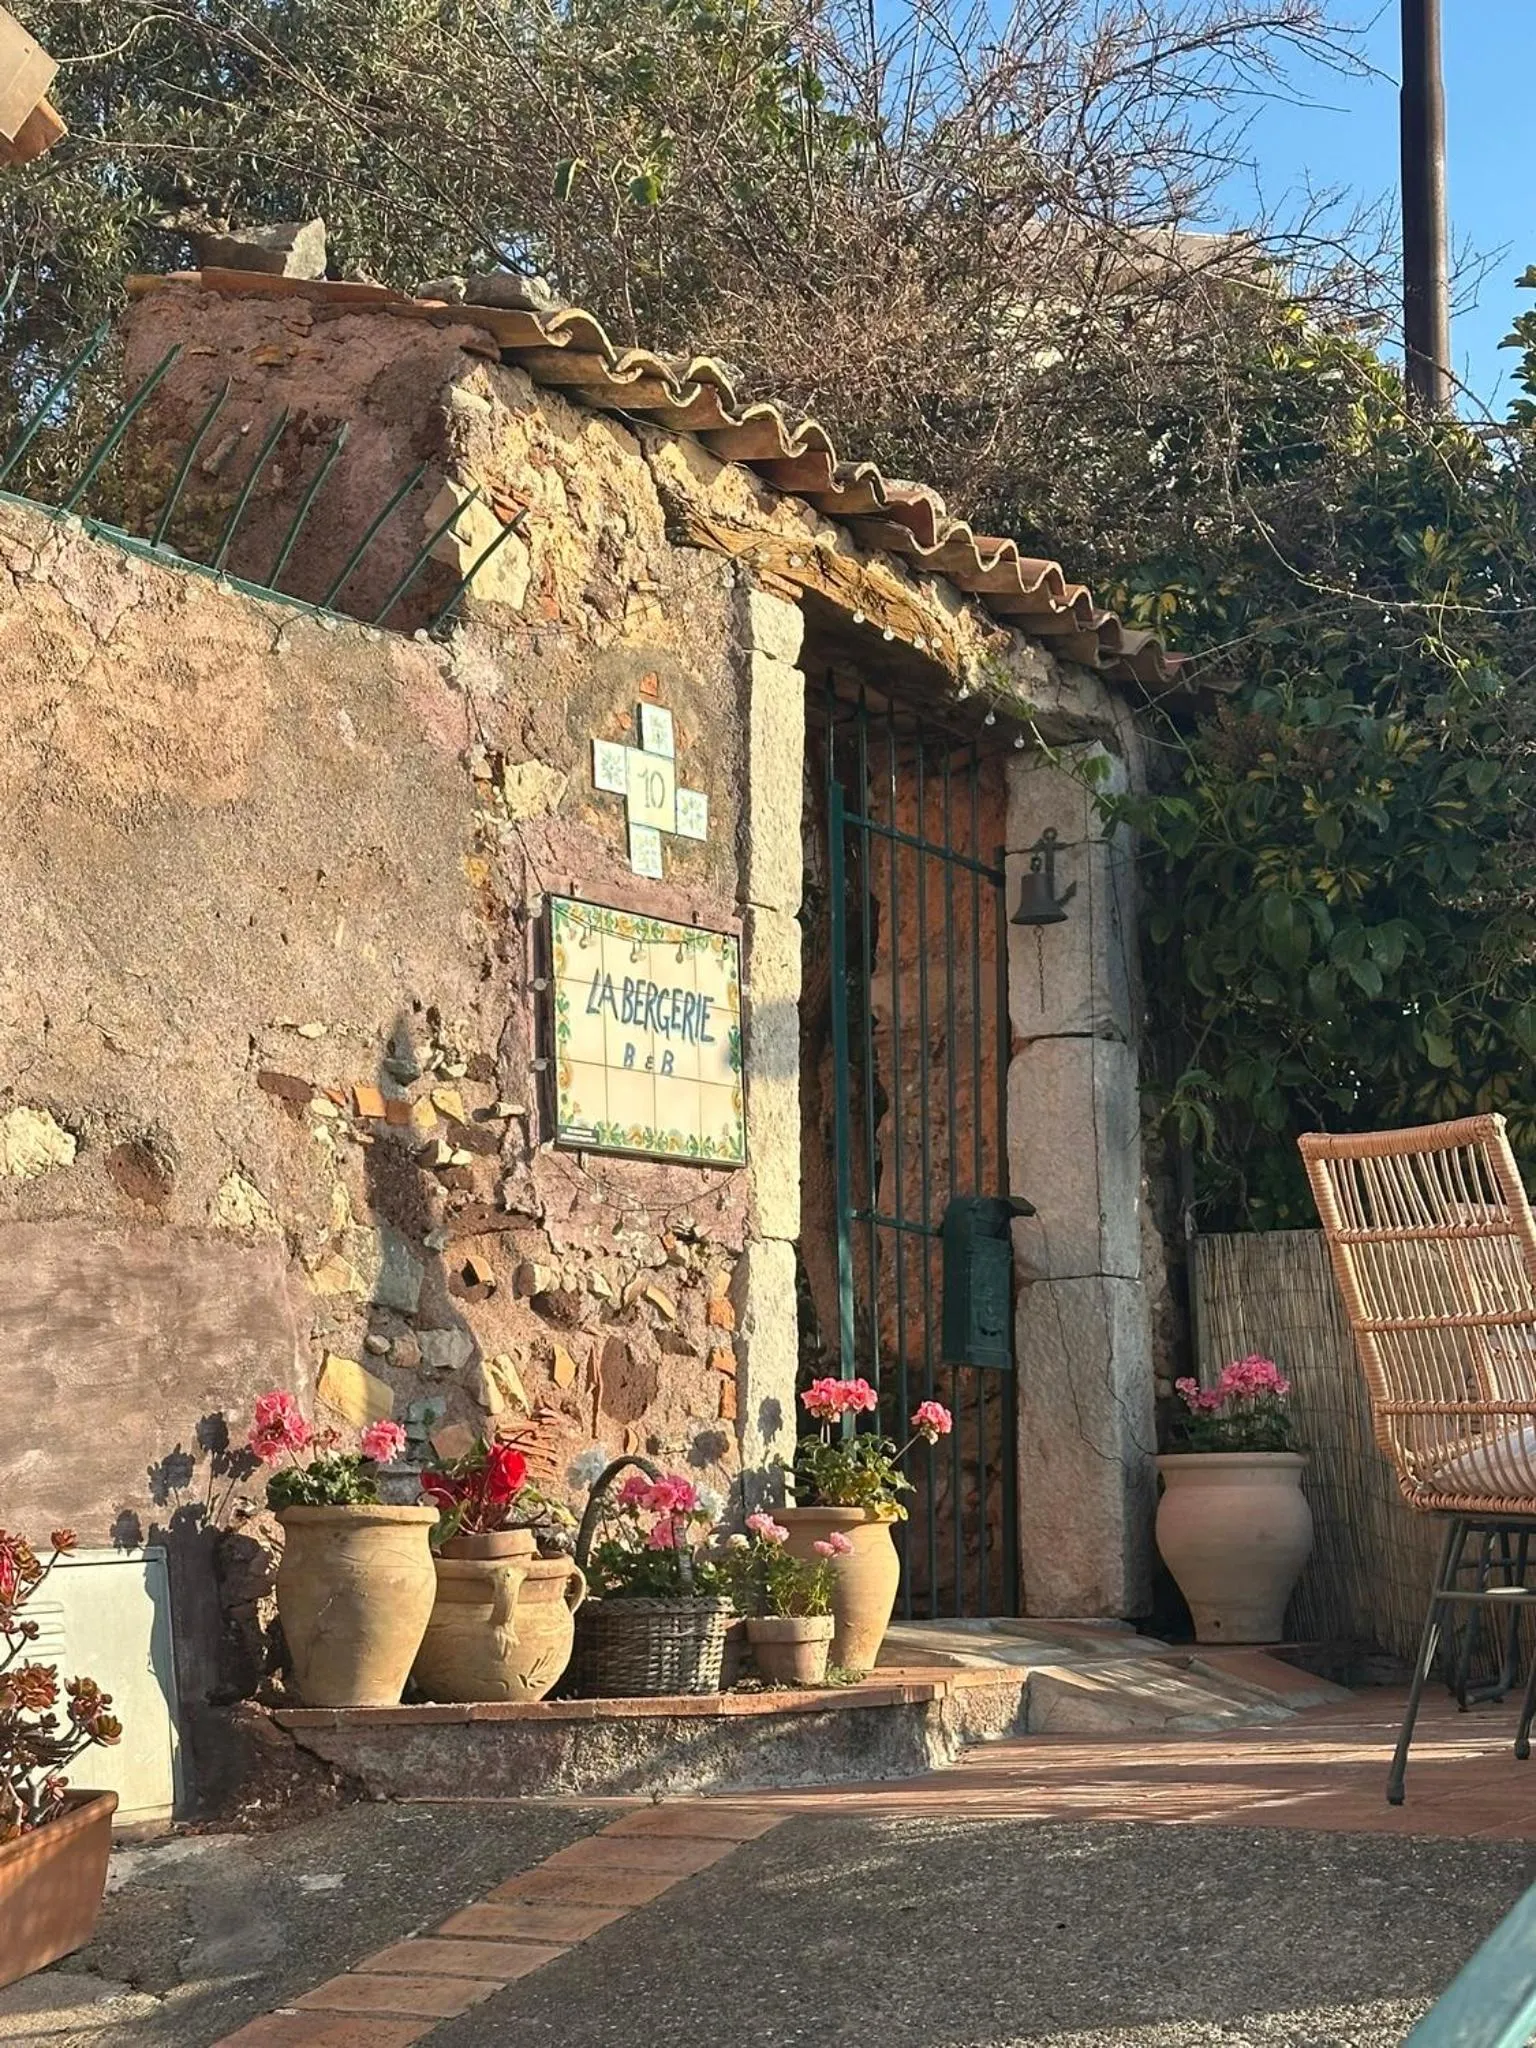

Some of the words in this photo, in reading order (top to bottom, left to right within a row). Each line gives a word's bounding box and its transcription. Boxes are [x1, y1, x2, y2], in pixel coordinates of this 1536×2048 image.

[637, 767, 666, 809] 10
[586, 967, 619, 1021] LA
[620, 975, 715, 1046] BERGERIE
[623, 1042, 636, 1067] B
[661, 1049, 674, 1076] B
